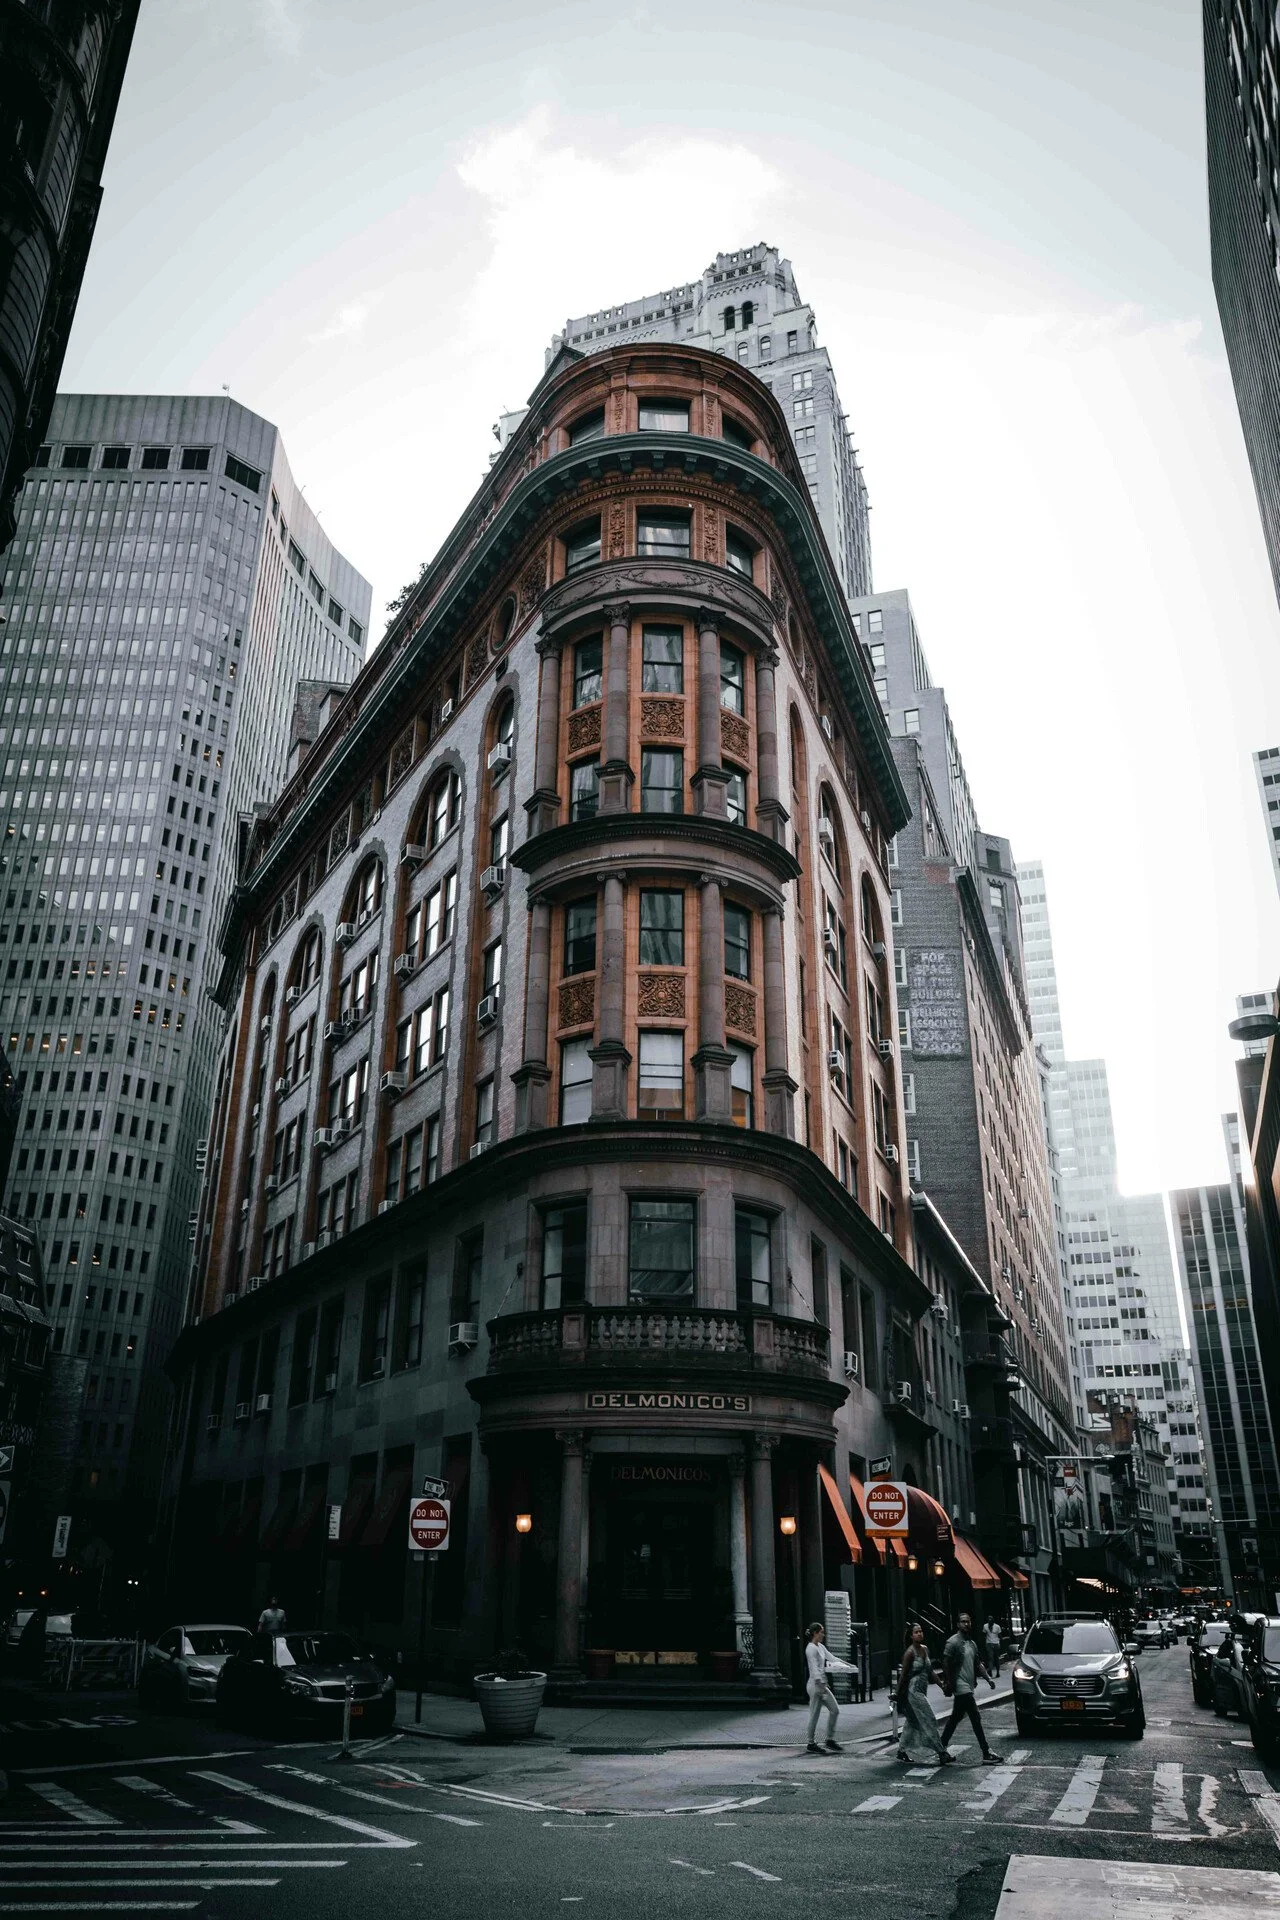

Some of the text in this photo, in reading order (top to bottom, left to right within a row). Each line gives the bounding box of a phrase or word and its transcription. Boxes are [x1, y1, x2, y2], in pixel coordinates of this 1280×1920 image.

[591, 1394, 746, 1410] DELMONICO'S
[872, 1492, 900, 1500] DO NOT
[416, 1508, 444, 1518] DO NOT
[873, 1512, 900, 1520] ENTER
[418, 1530, 441, 1539] ENTER
